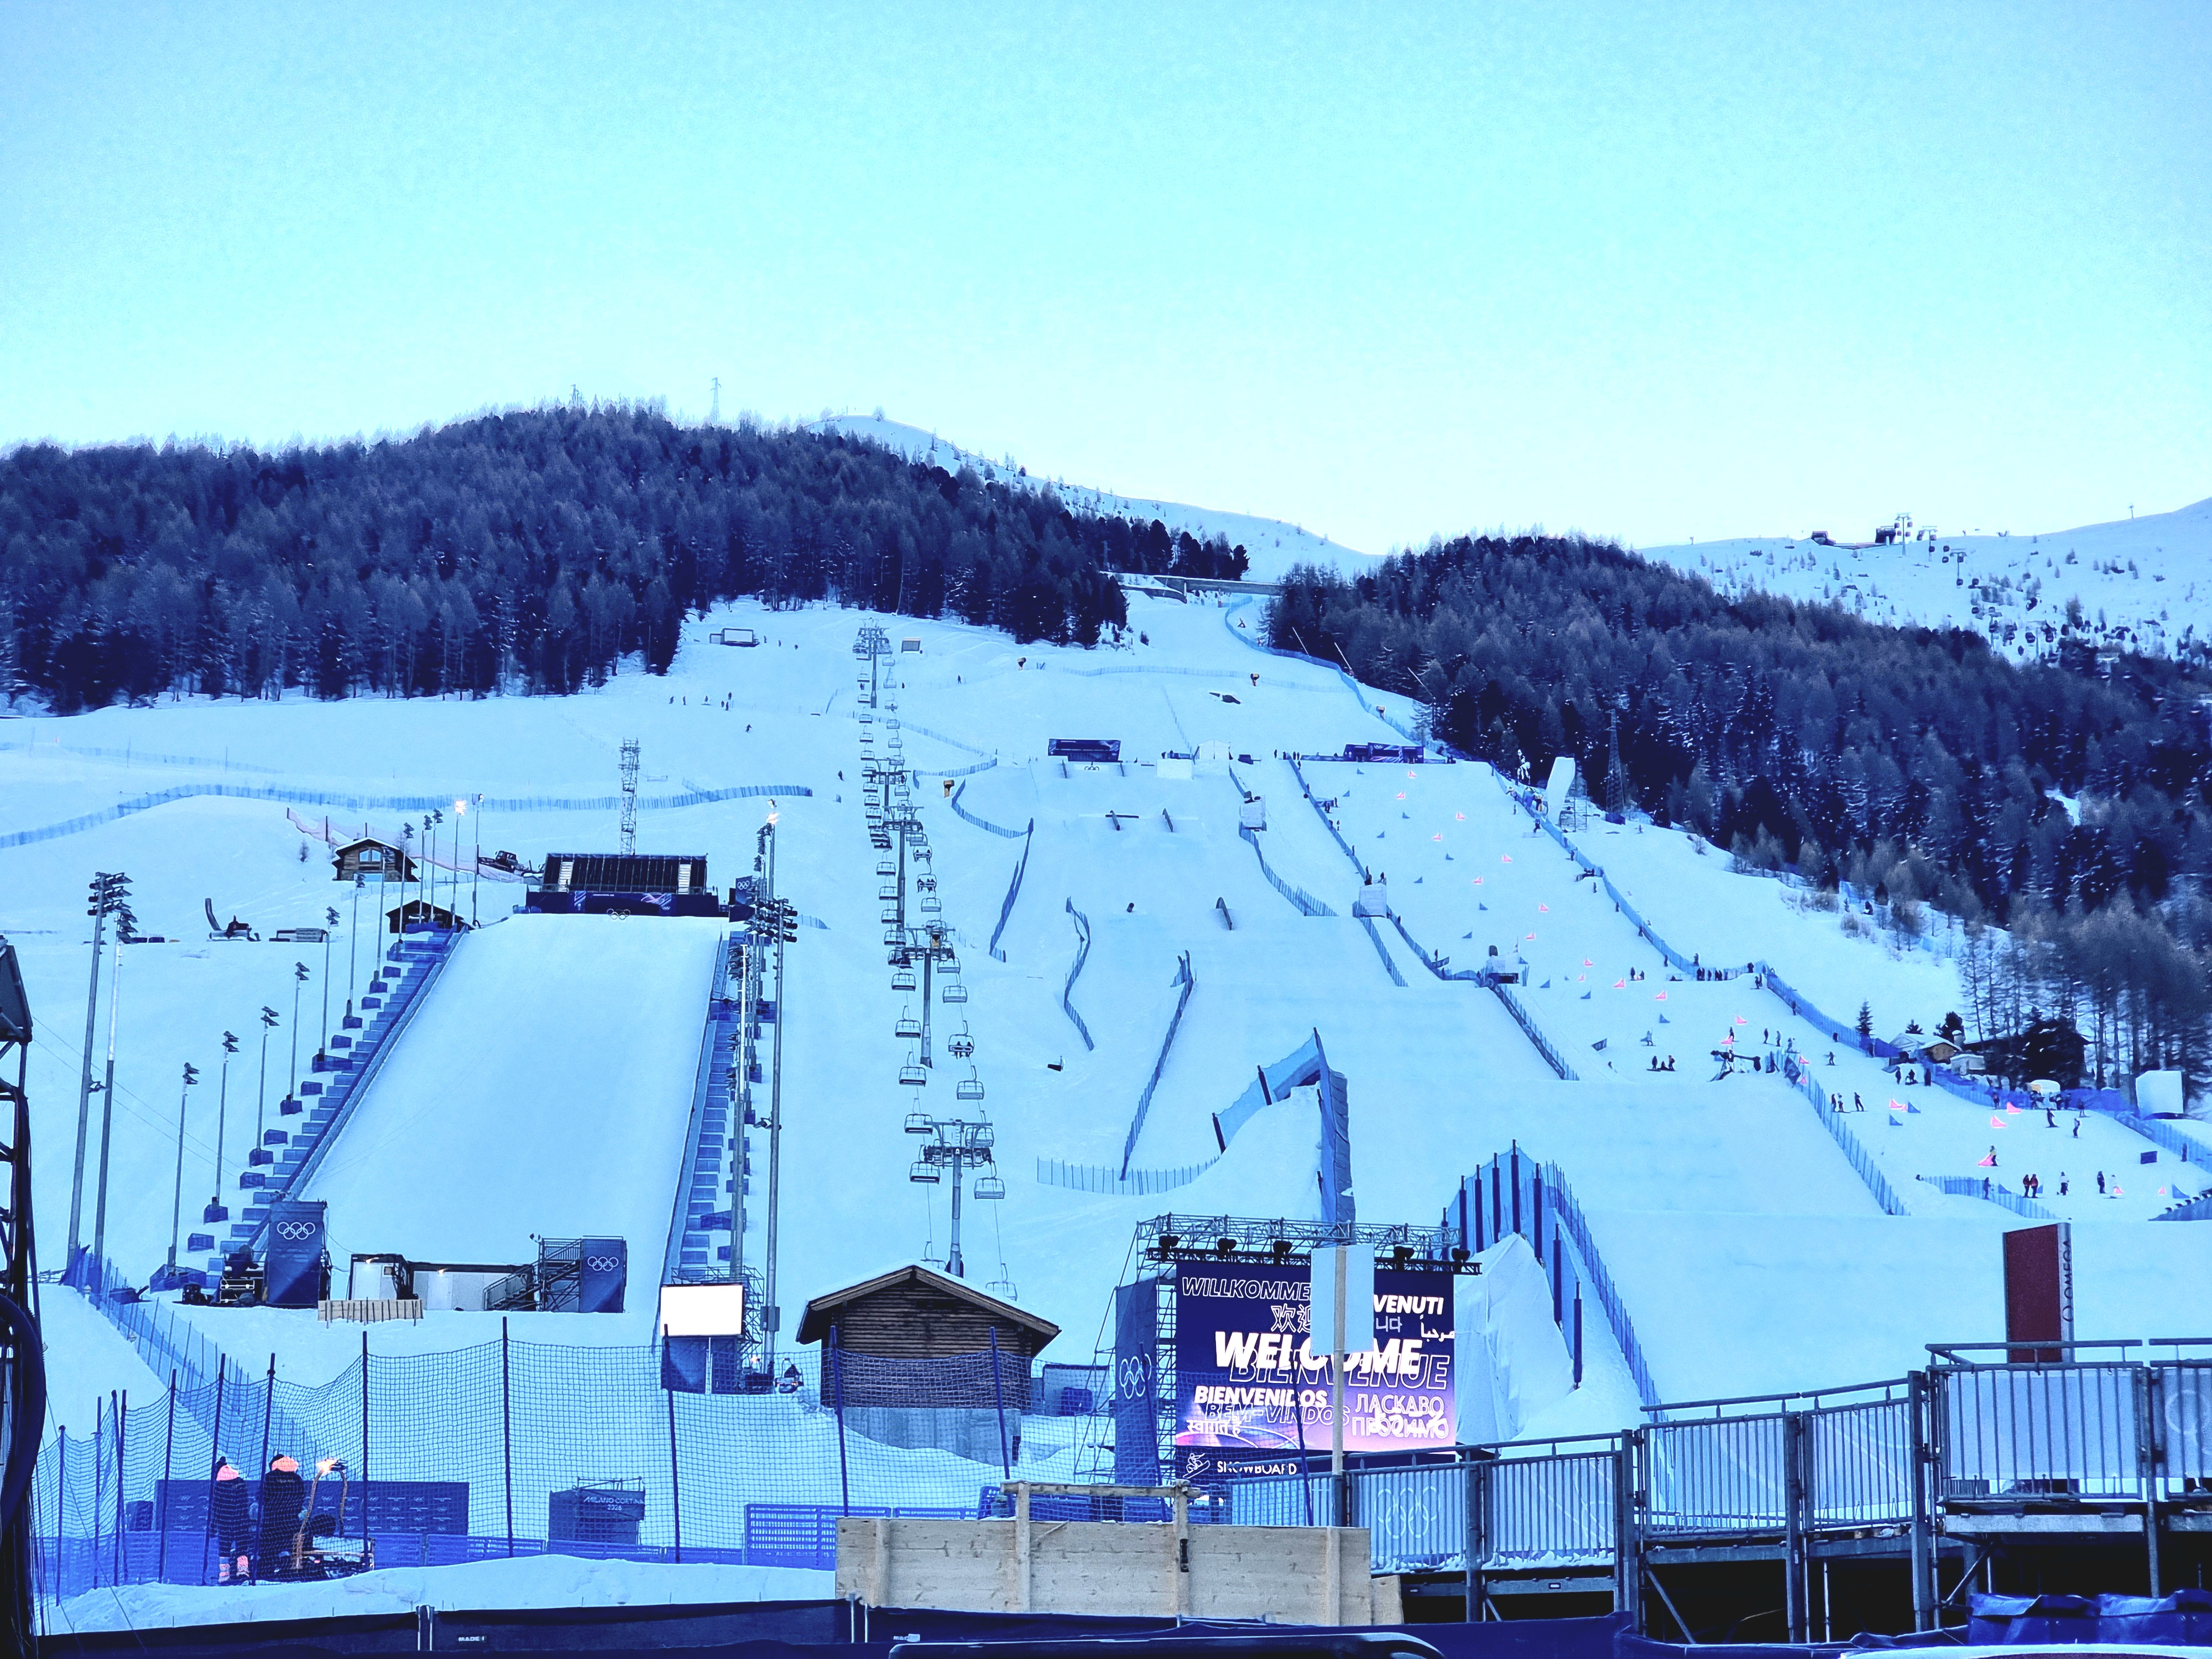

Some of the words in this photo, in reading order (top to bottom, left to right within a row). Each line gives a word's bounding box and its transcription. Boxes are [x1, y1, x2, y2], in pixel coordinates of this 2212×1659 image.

[2063, 1240, 2073, 1300] OMEGA
[1182, 1277, 1311, 1301] WILLKOMME
[1374, 1295, 1444, 1314] VENUTI
[1194, 1385, 1328, 1407] BIENVENIDOS
[1355, 1394, 1444, 1415] ЛАСКАВО
